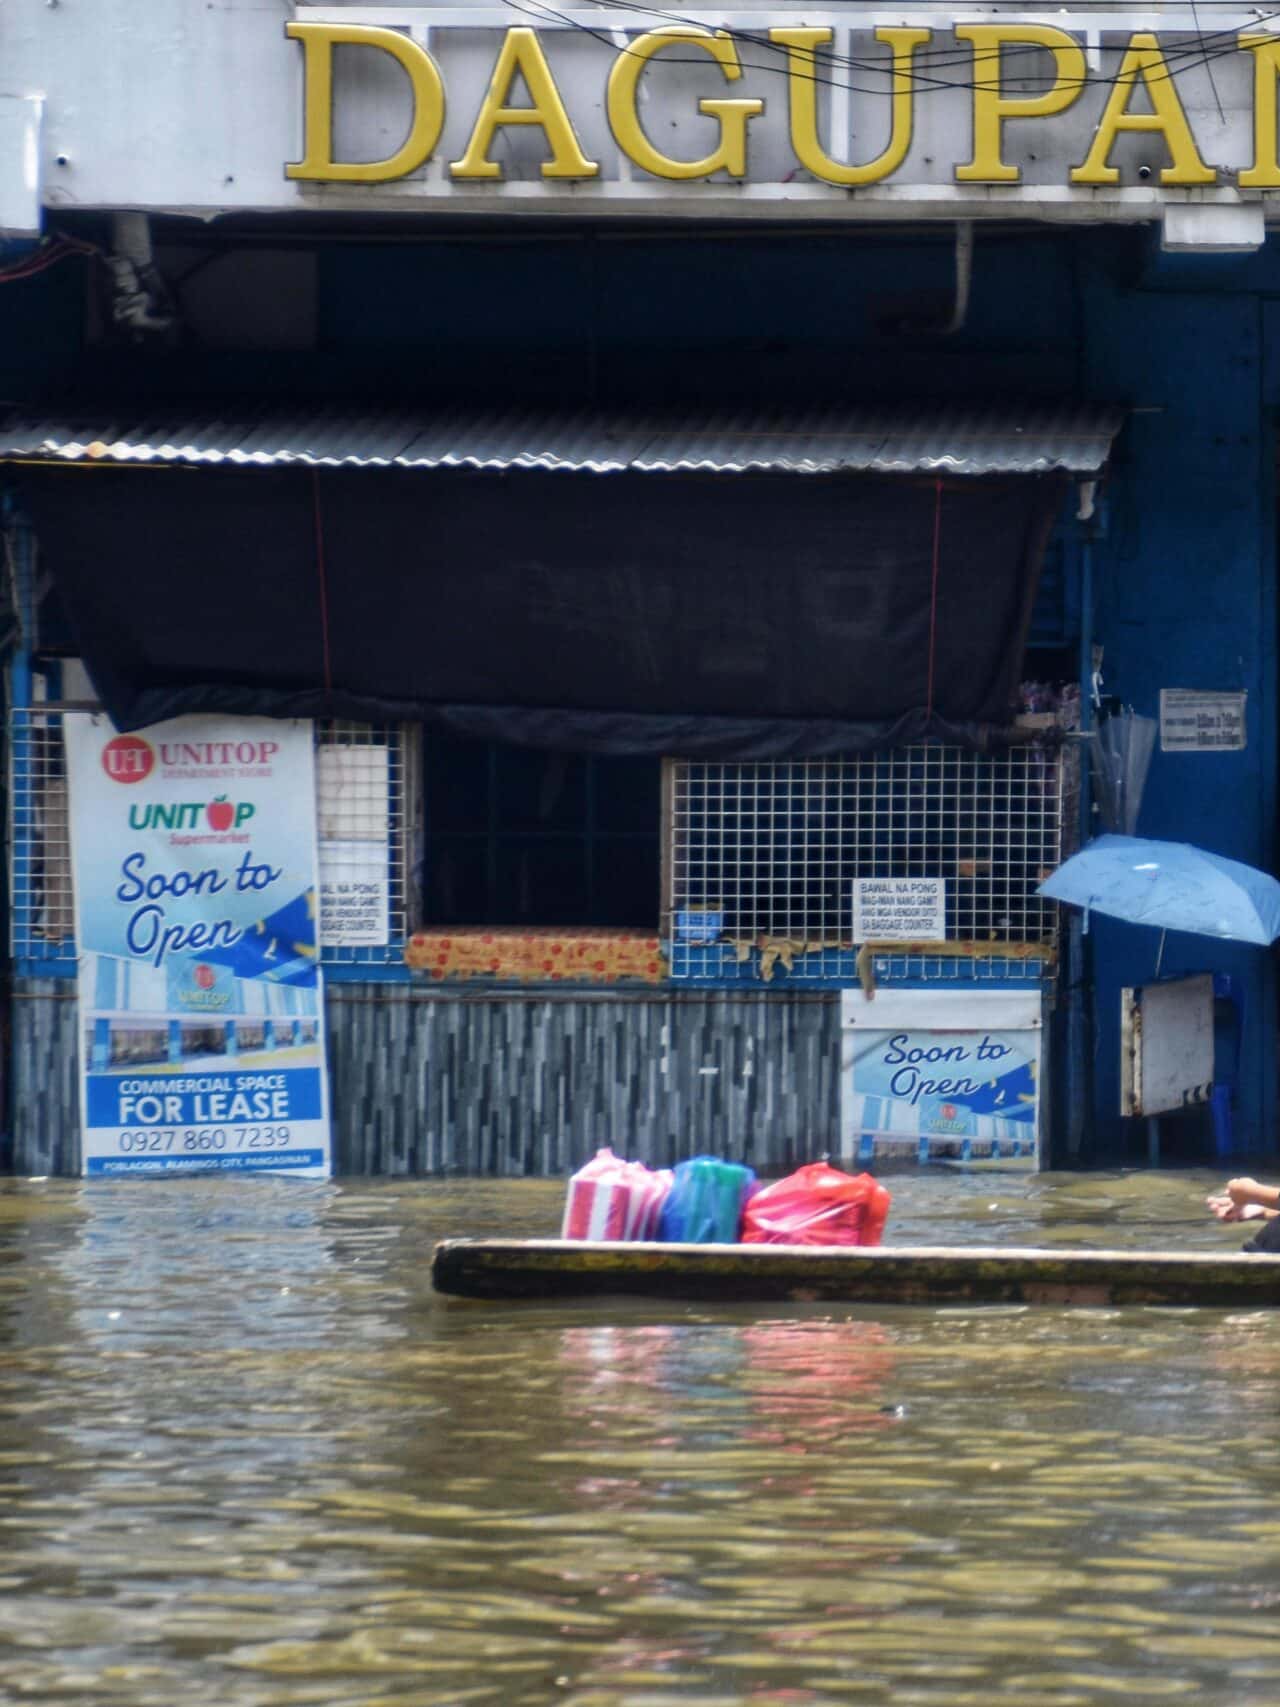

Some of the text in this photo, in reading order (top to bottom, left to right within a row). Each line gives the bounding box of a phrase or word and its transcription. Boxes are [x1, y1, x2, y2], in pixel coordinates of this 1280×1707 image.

[158, 741, 279, 765] UNITOP
[168, 833, 249, 846] Supermarket
[117, 850, 282, 902] Soon to
[861, 883, 938, 894] BAWAL NA PONG
[127, 904, 242, 968] Open
[884, 1034, 1012, 1064] Soon to
[119, 1075, 286, 1095] COMMERCIAL SPACE
[890, 1066, 978, 1106] Open
[119, 1091, 289, 1123] FOR LEASE
[119, 1126, 290, 1152] 0927 860 7239
